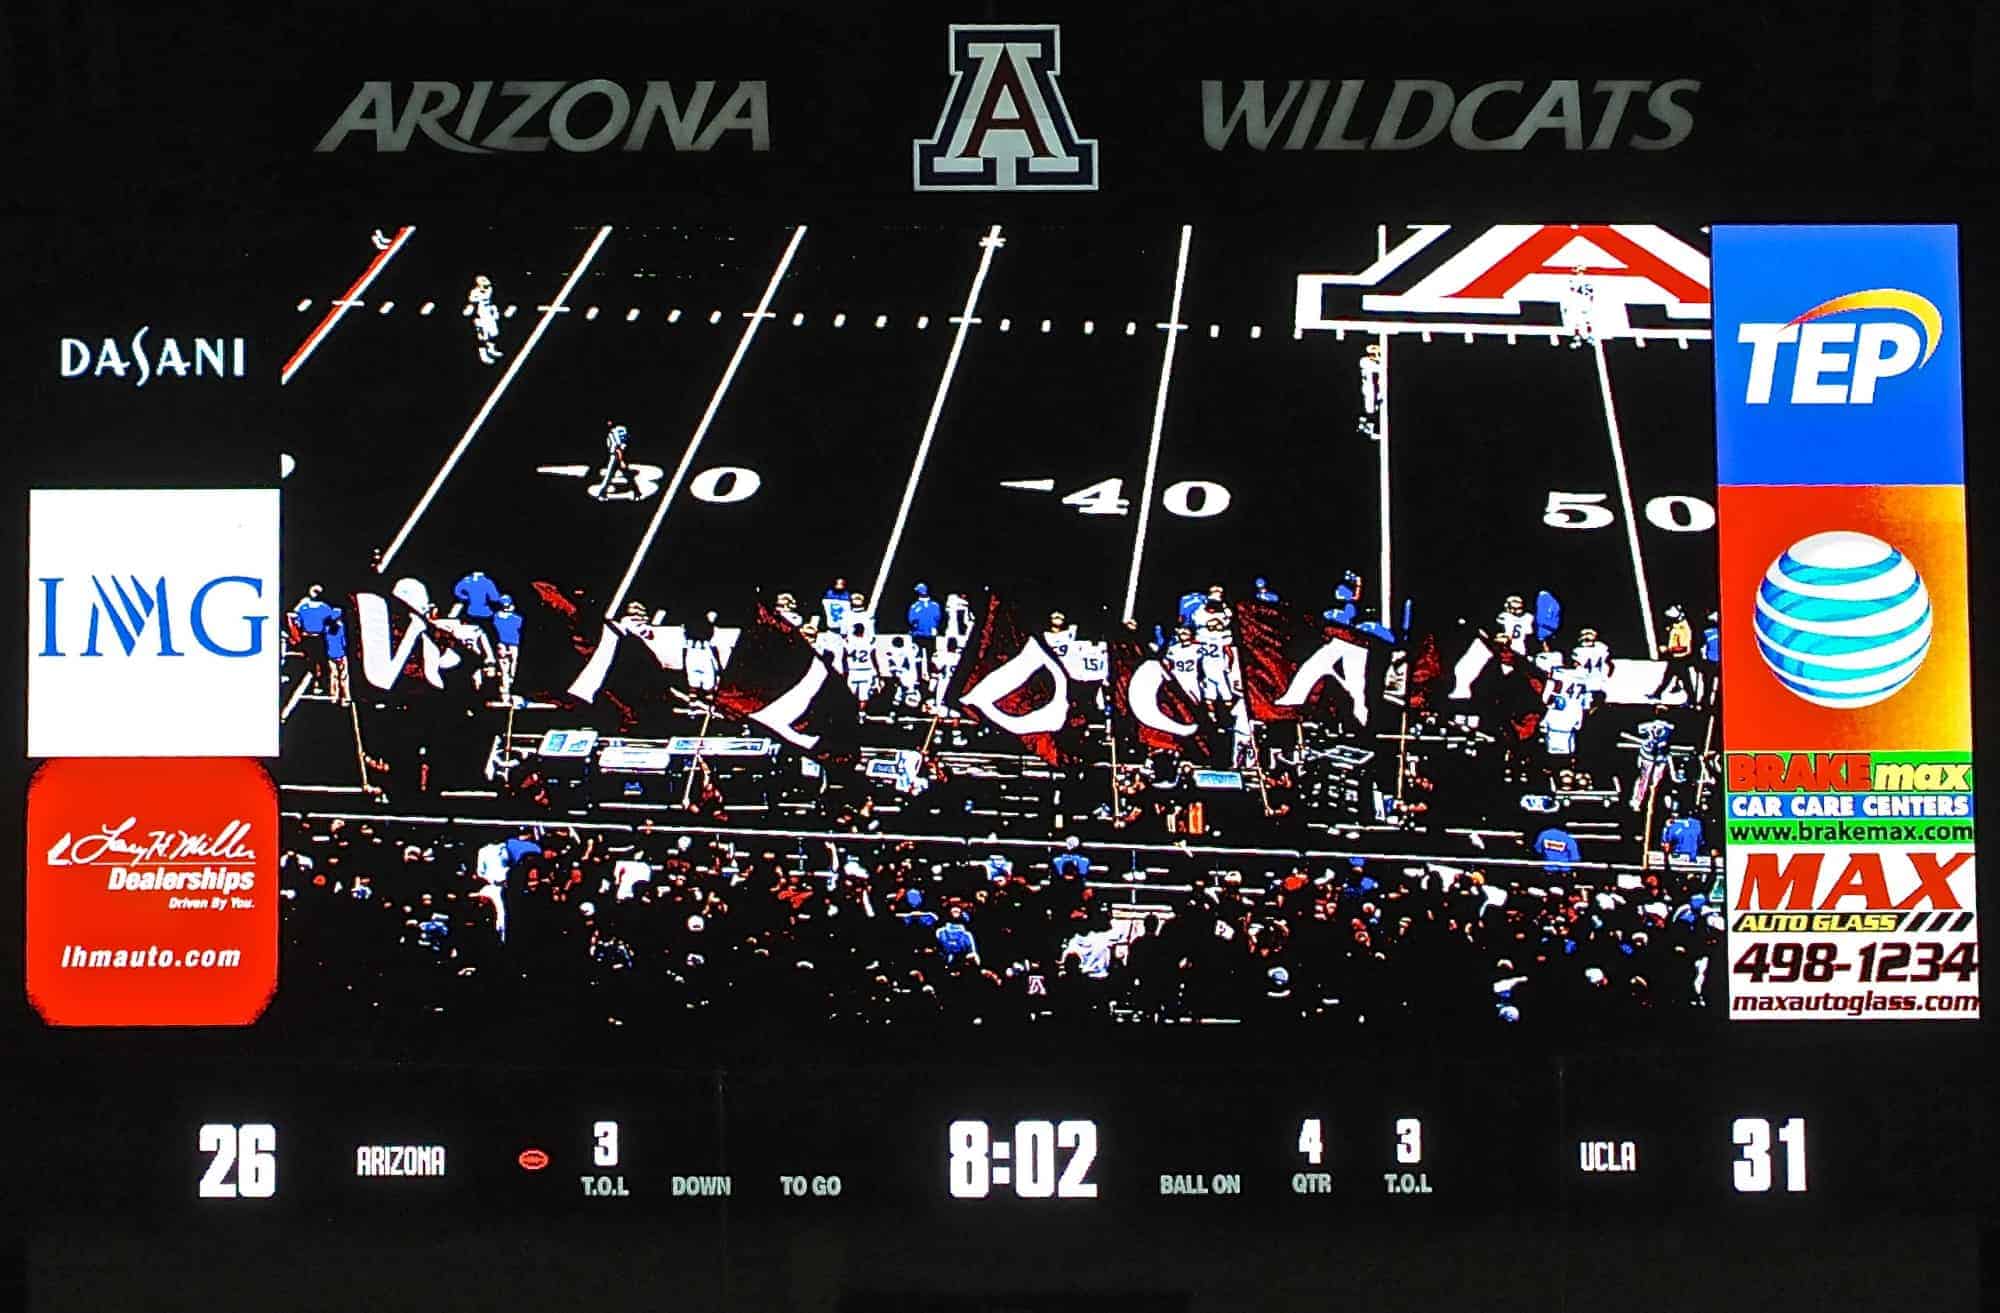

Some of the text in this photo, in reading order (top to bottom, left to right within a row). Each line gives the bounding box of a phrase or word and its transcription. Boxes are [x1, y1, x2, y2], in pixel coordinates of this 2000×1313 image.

[313, 79, 770, 153] ARIZONA
[914, 24, 1099, 192] A
[1202, 79, 1701, 151] WILDCATS
[61, 326, 244, 387] DASANI
[1737, 322, 1921, 405] TEP
[38, 574, 269, 658] IMG
[1176, 660, 1195, 672] 92
[1727, 753, 1971, 792] BRAKE max
[1732, 796, 1969, 817] CAR CARE CENTERS
[168, 820, 256, 860] Miller
[1730, 822, 1974, 841] www.brakemax.com
[108, 867, 255, 895] Dealerships
[1735, 853, 1975, 910] MAX
[168, 897, 208, 909] Driven
[210, 897, 227, 911] By
[1738, 915, 1898, 931] AUTO GLASS
[61, 946, 240, 968] lhmauto.com
[1733, 942, 1981, 983] 498-1234
[1733, 991, 1980, 1015] maxautoglass.com
[199, 1123, 276, 1198] 26
[593, 1121, 618, 1166] 3
[949, 1119, 1098, 1198] 8:02
[1298, 1118, 1323, 1164] 4
[1396, 1118, 1421, 1164] 3
[1580, 1141, 1636, 1172] UCLA
[1732, 1118, 1807, 1192] 31
[356, 1145, 446, 1177] ARIZONA
[671, 1175, 732, 1197] DOWN
[779, 1175, 842, 1197] TO GO
[1160, 1173, 1241, 1195] BALL ON
[1291, 1172, 1332, 1195] QTR
